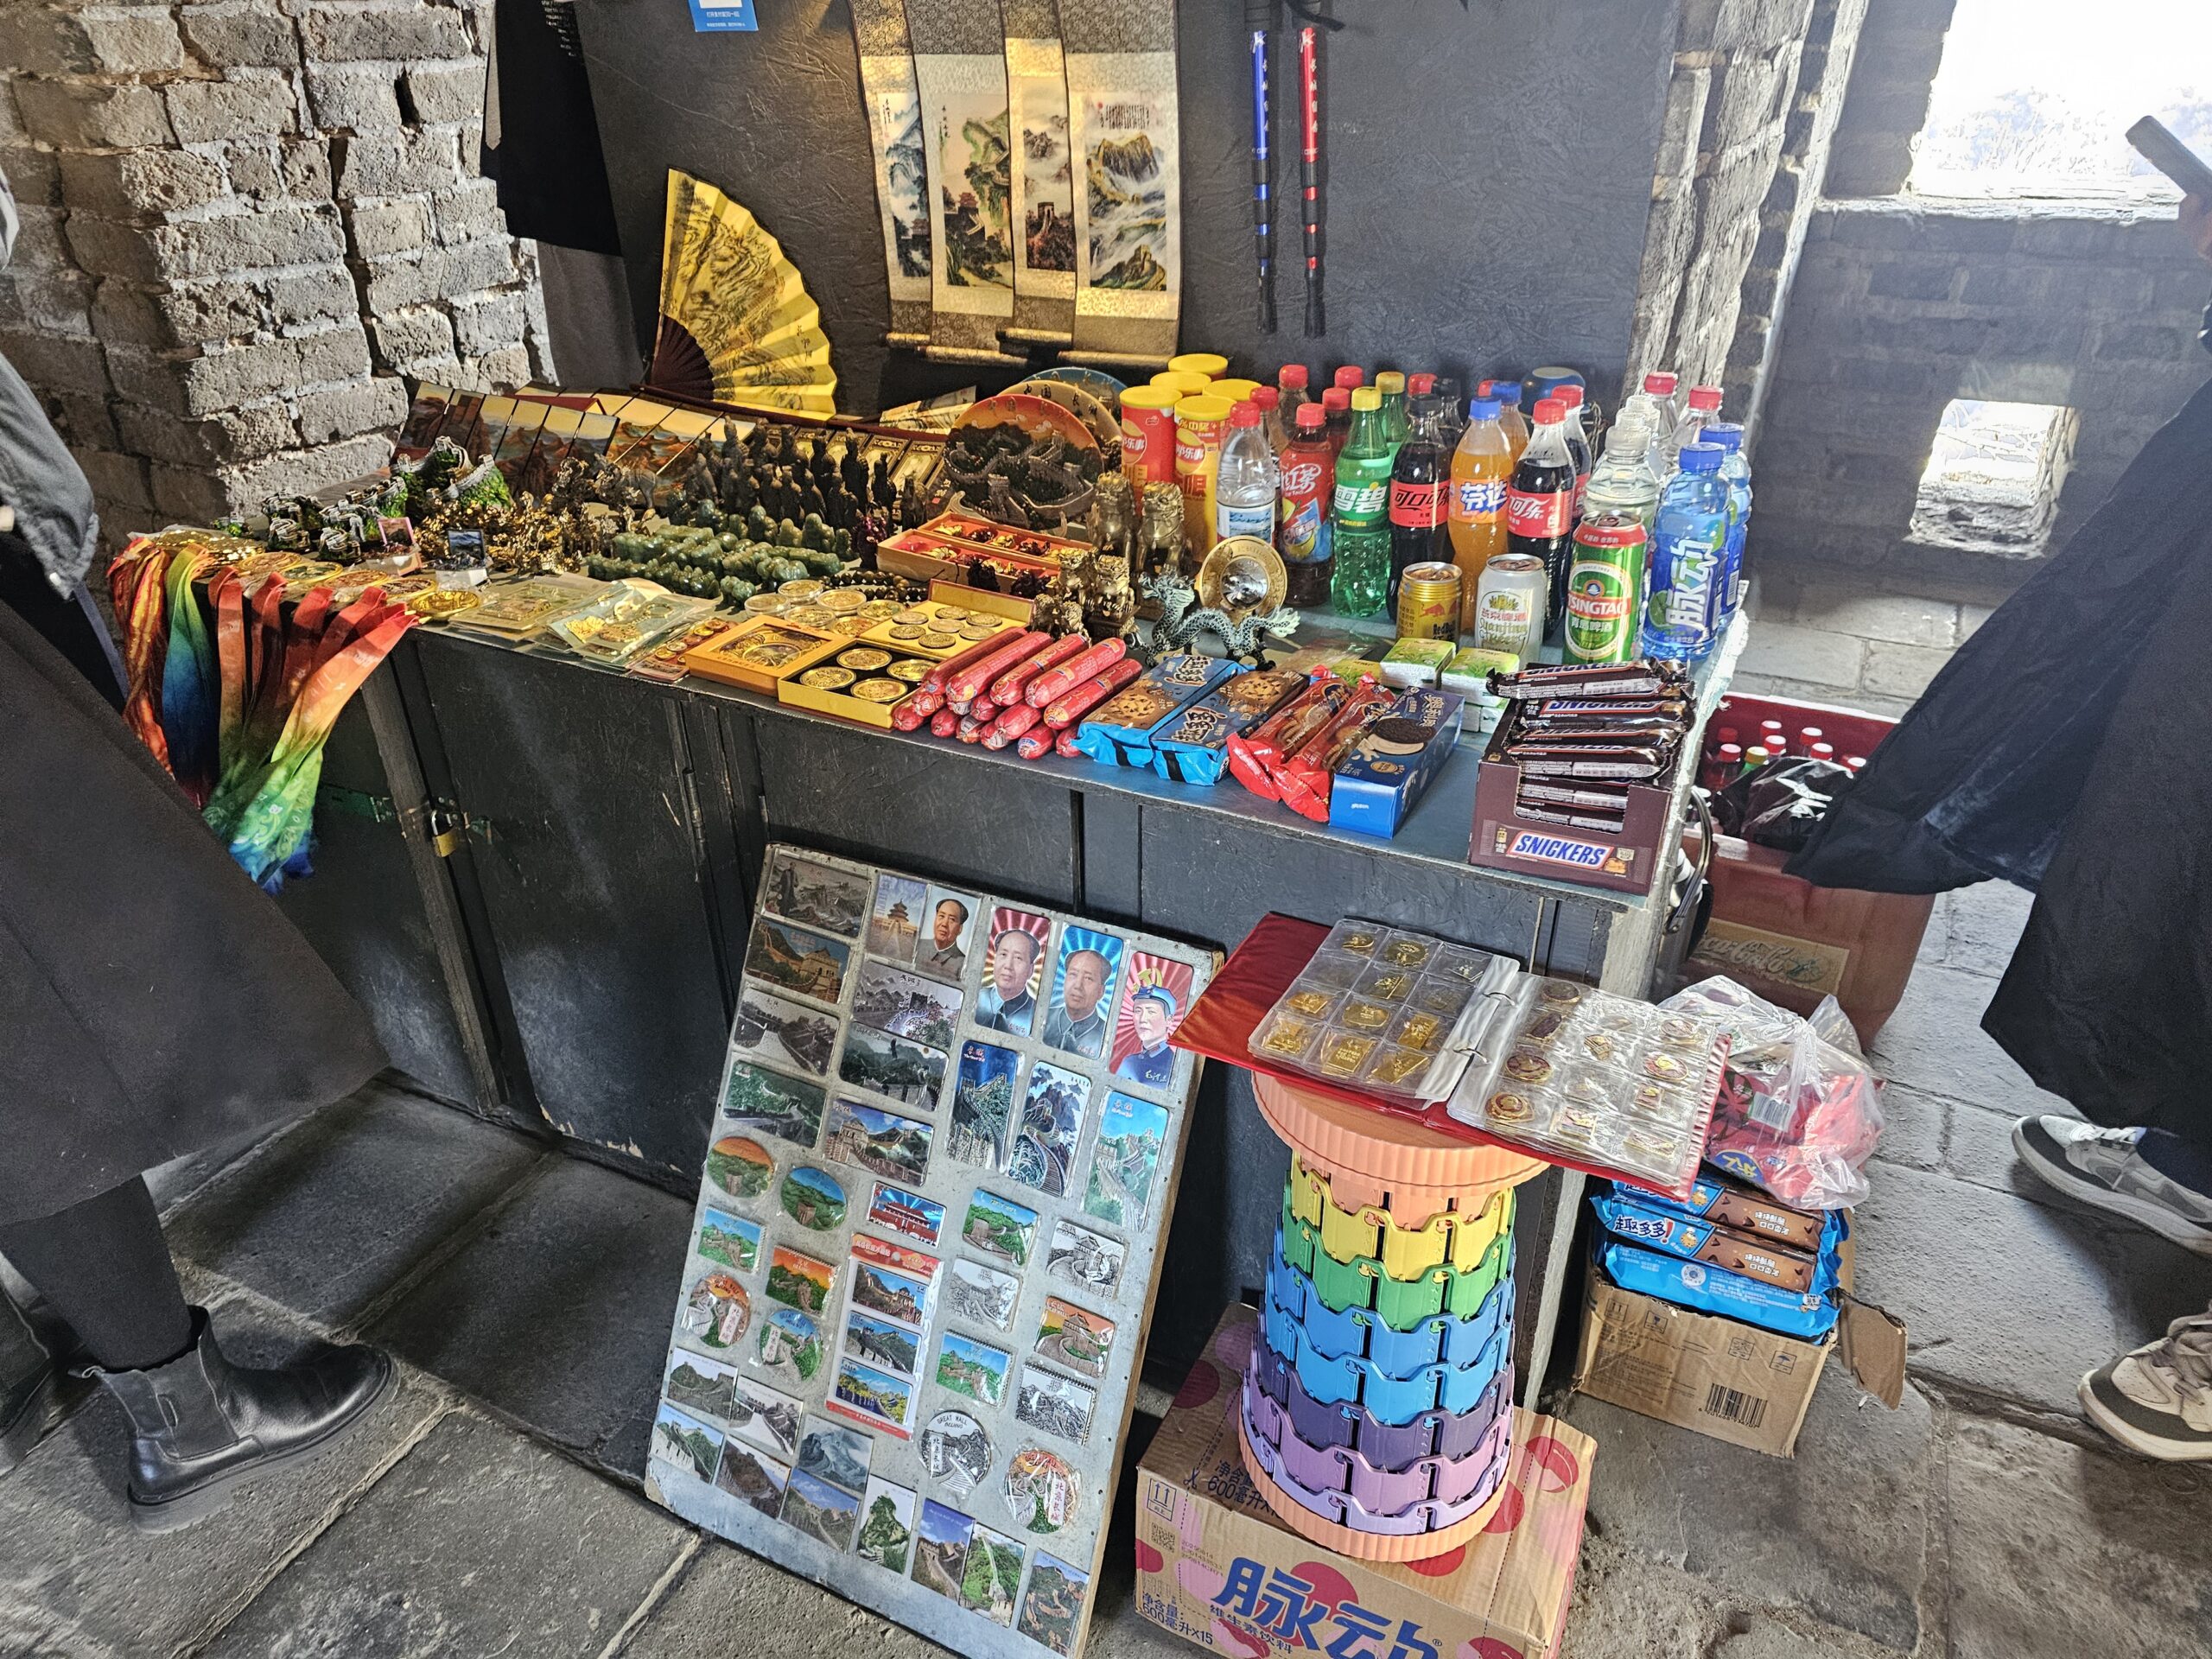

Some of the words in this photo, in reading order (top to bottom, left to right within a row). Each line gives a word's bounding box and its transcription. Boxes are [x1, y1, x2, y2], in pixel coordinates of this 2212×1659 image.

[1334, 484, 1388, 514] 雪碧
[1460, 480, 1508, 512] 芬达
[1568, 593, 1629, 615] TSINGTAO
[1571, 616, 1613, 633] 青岛啤酒
[1514, 834, 1606, 866] SNICKERS
[1614, 1215, 1674, 1244] 趣多多!
[937, 1414, 952, 1425] GREAT
[956, 1415, 968, 1425] WALL
[1051, 1481, 1065, 1522] 北京长城
[1211, 1556, 1439, 1659] 脉动
[1210, 1603, 1294, 1655] 维生素饮料
